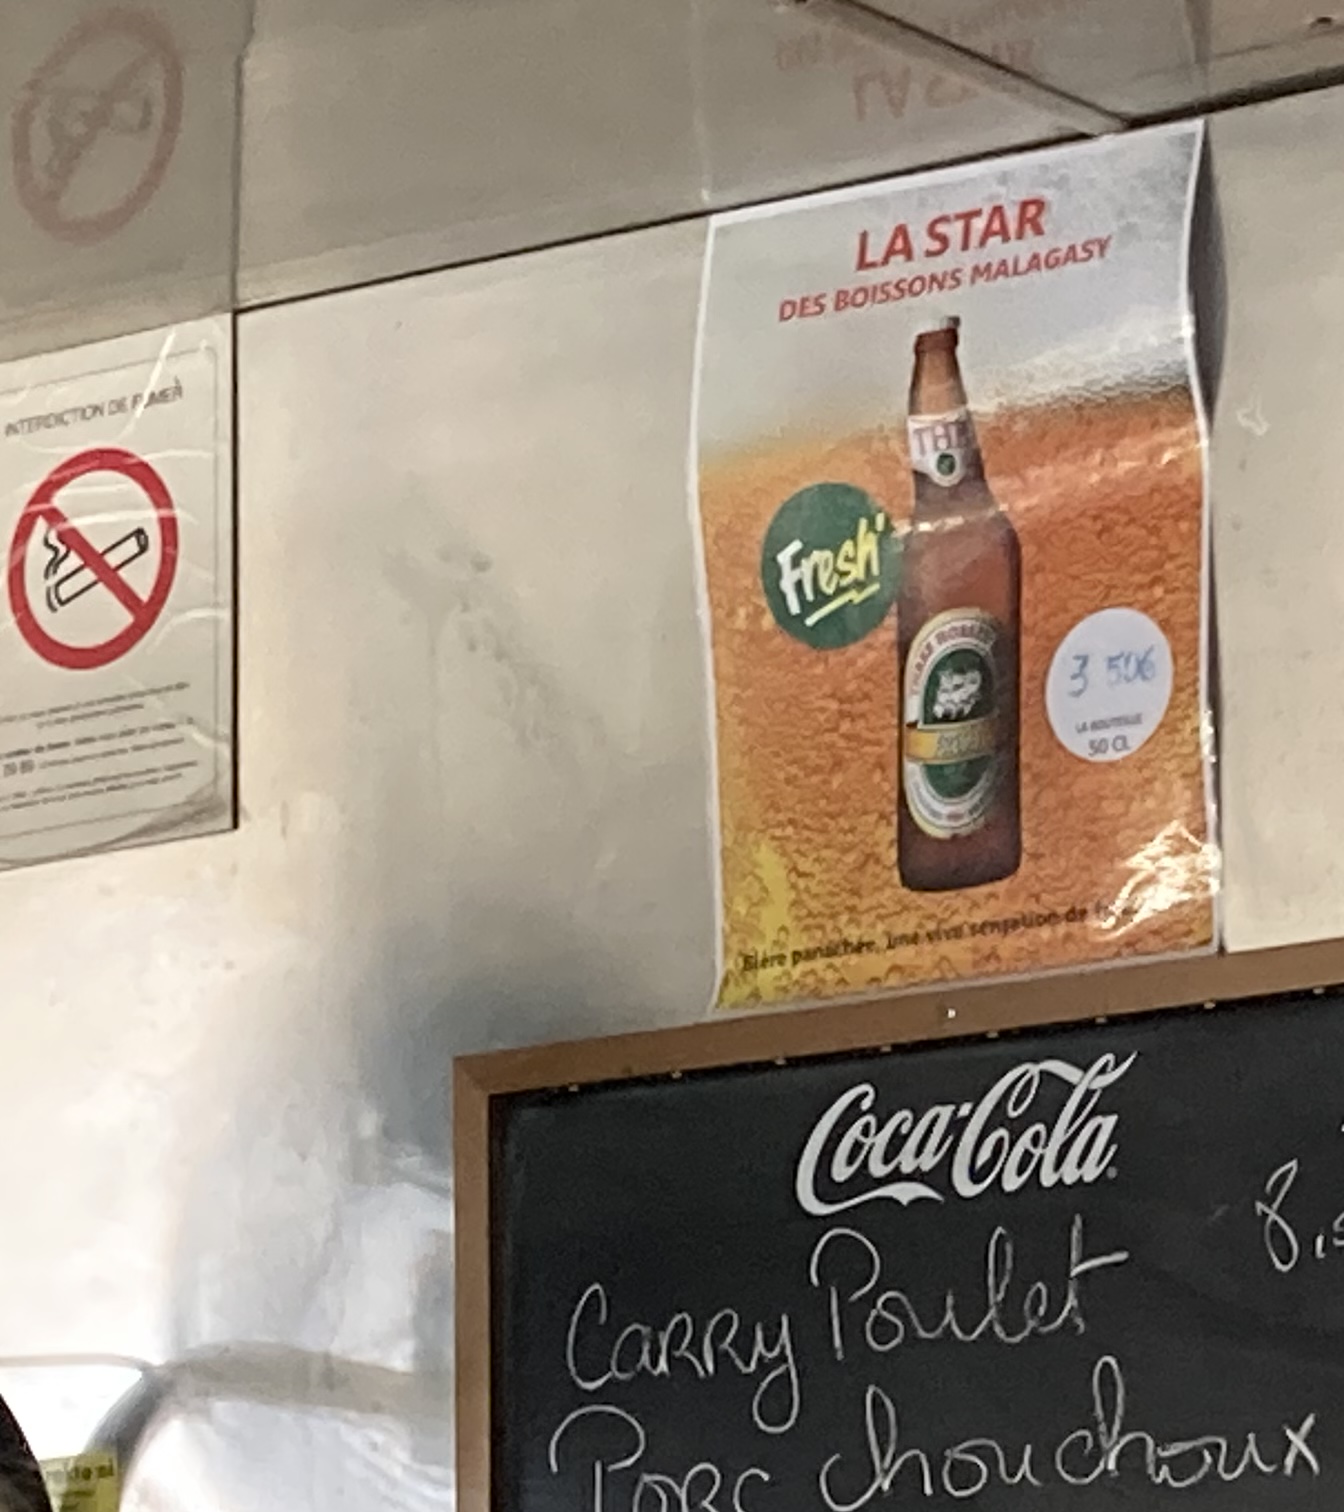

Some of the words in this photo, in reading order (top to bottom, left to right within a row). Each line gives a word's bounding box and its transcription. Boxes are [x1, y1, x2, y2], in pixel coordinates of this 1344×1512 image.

[855, 223, 913, 272] LA
[924, 197, 1046, 258] STAR
[778, 296, 826, 322] DES
[834, 268, 962, 312] BOISSONS
[970, 236, 1113, 287] MALAGASY
[810, 1213, 1130, 1362] Poulet
